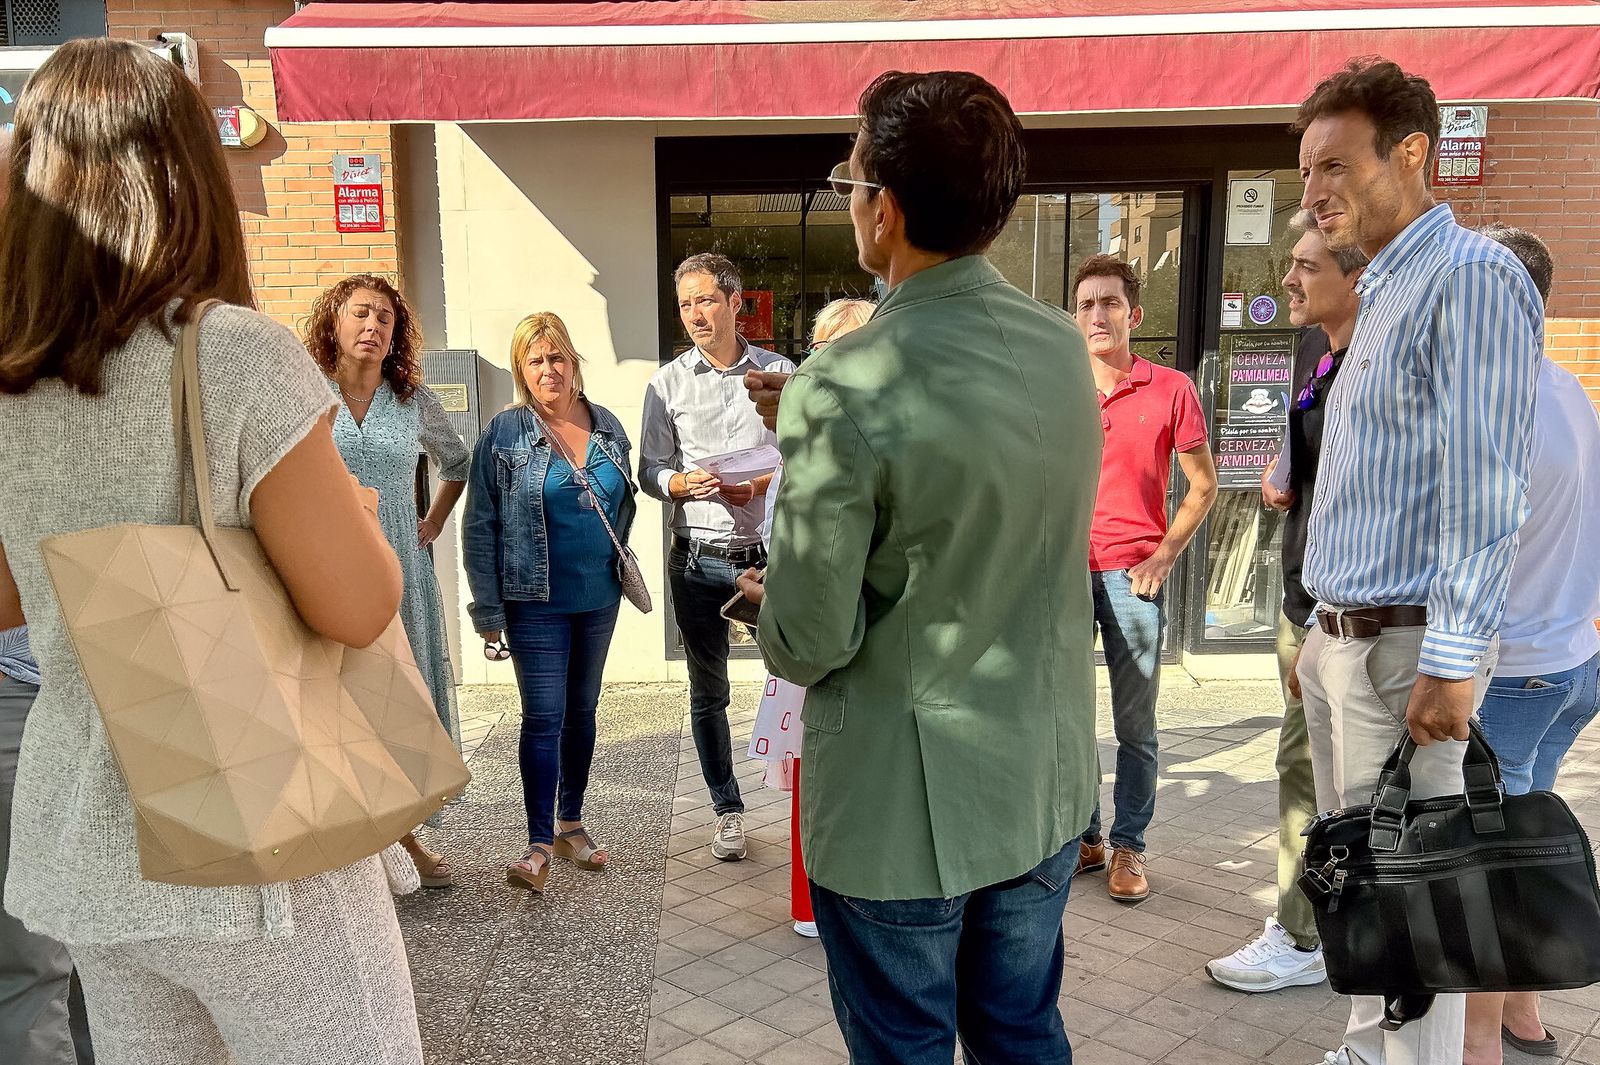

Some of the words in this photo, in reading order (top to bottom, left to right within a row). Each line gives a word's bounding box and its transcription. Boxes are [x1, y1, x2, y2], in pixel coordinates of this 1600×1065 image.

[1446, 120, 1478, 134] Direct
[1440, 140, 1481, 150] Alarma
[342, 167, 371, 181] Direct
[338, 187, 379, 197] Alarma
[1237, 353, 1286, 365] CERVEZA
[1232, 369, 1290, 382] PA'MIALMEJA
[1219, 440, 1276, 452] CERVEZA
